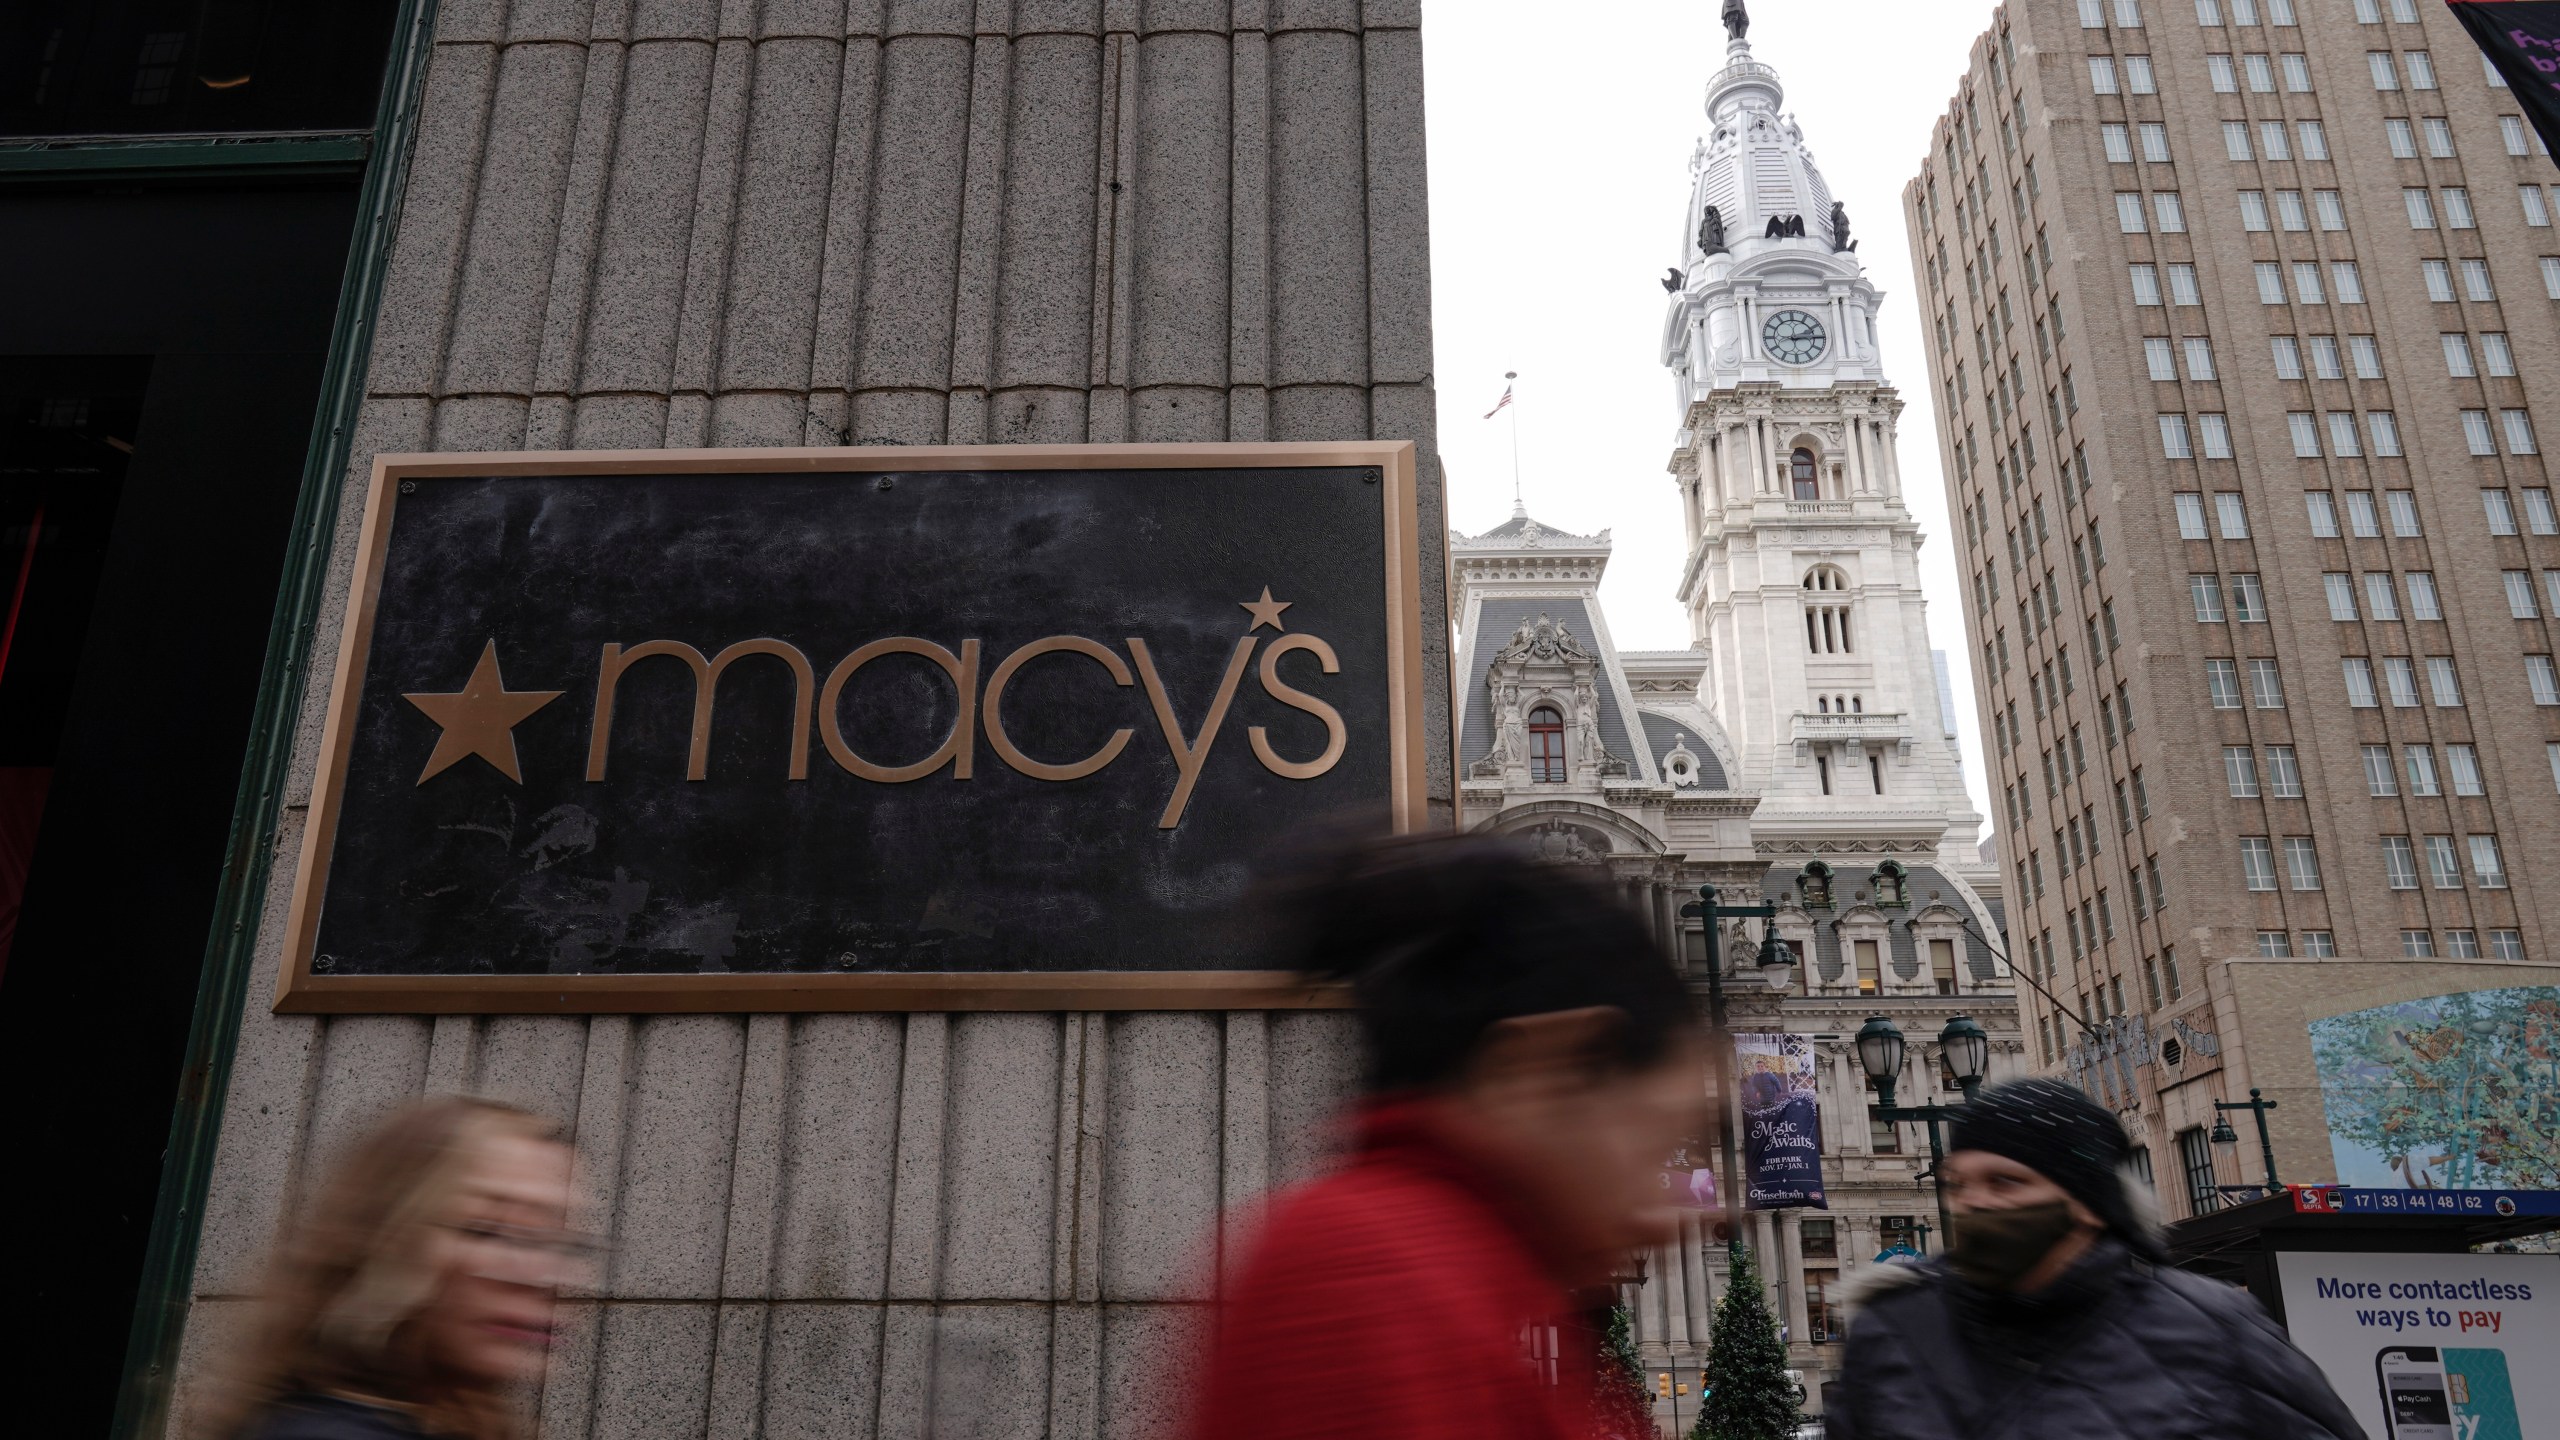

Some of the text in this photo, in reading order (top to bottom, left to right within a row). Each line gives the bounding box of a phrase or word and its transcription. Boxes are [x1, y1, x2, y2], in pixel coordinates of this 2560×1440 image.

[1752, 1121, 1798, 1139] Magic
[1764, 1133, 1816, 1151] Awaits
[1760, 1164, 1776, 1172] NOV.
[1788, 1162, 1804, 1170] JAN.
[1765, 1155, 1802, 1165] FDR PARK
[1750, 1188, 1804, 1201] Tinseltown
[2354, 1195, 2369, 1207] 17
[2381, 1195, 2398, 1208] 33
[2409, 1195, 2426, 1208] 44
[2437, 1196, 2454, 1208] 48
[2465, 1196, 2482, 1209] 62
[2316, 1277, 2532, 1301] More contactless
[2356, 1307, 2501, 1333] ways to pay
